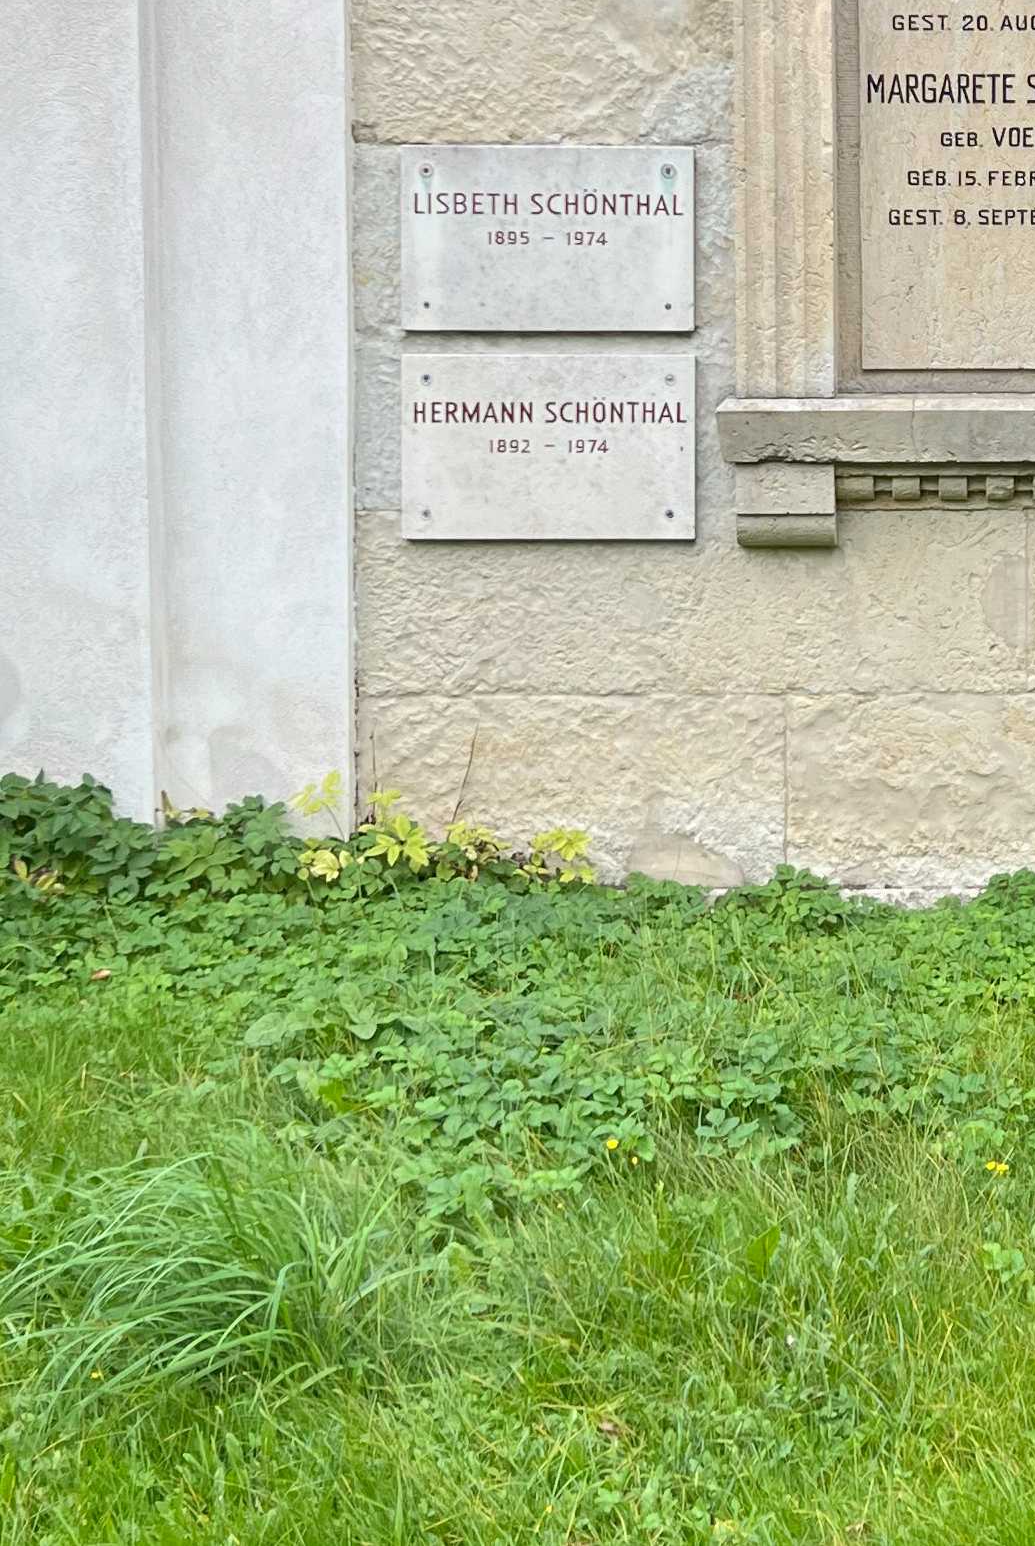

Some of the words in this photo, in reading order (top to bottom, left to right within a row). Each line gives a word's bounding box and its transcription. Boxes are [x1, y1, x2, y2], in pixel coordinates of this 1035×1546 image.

[892, 15, 951, 32] GEST.
[962, 15, 994, 32] 20.
[867, 73, 1016, 104] MARGARETE
[940, 132, 983, 148] GEB.
[907, 170, 952, 187] GEB.
[957, 170, 982, 187] 15.
[414, 193, 519, 215] LISBETH
[530, 188, 684, 216] SCHÖNTHAL
[888, 209, 944, 226] GEST.
[954, 210, 971, 227] 8.
[486, 231, 530, 246] 1895
[565, 231, 608, 246] 1974
[413, 402, 535, 424] HERMANN
[544, 397, 688, 424] SCHÖNTHAL
[488, 439, 531, 454] 1892
[567, 439, 609, 454] 1974
